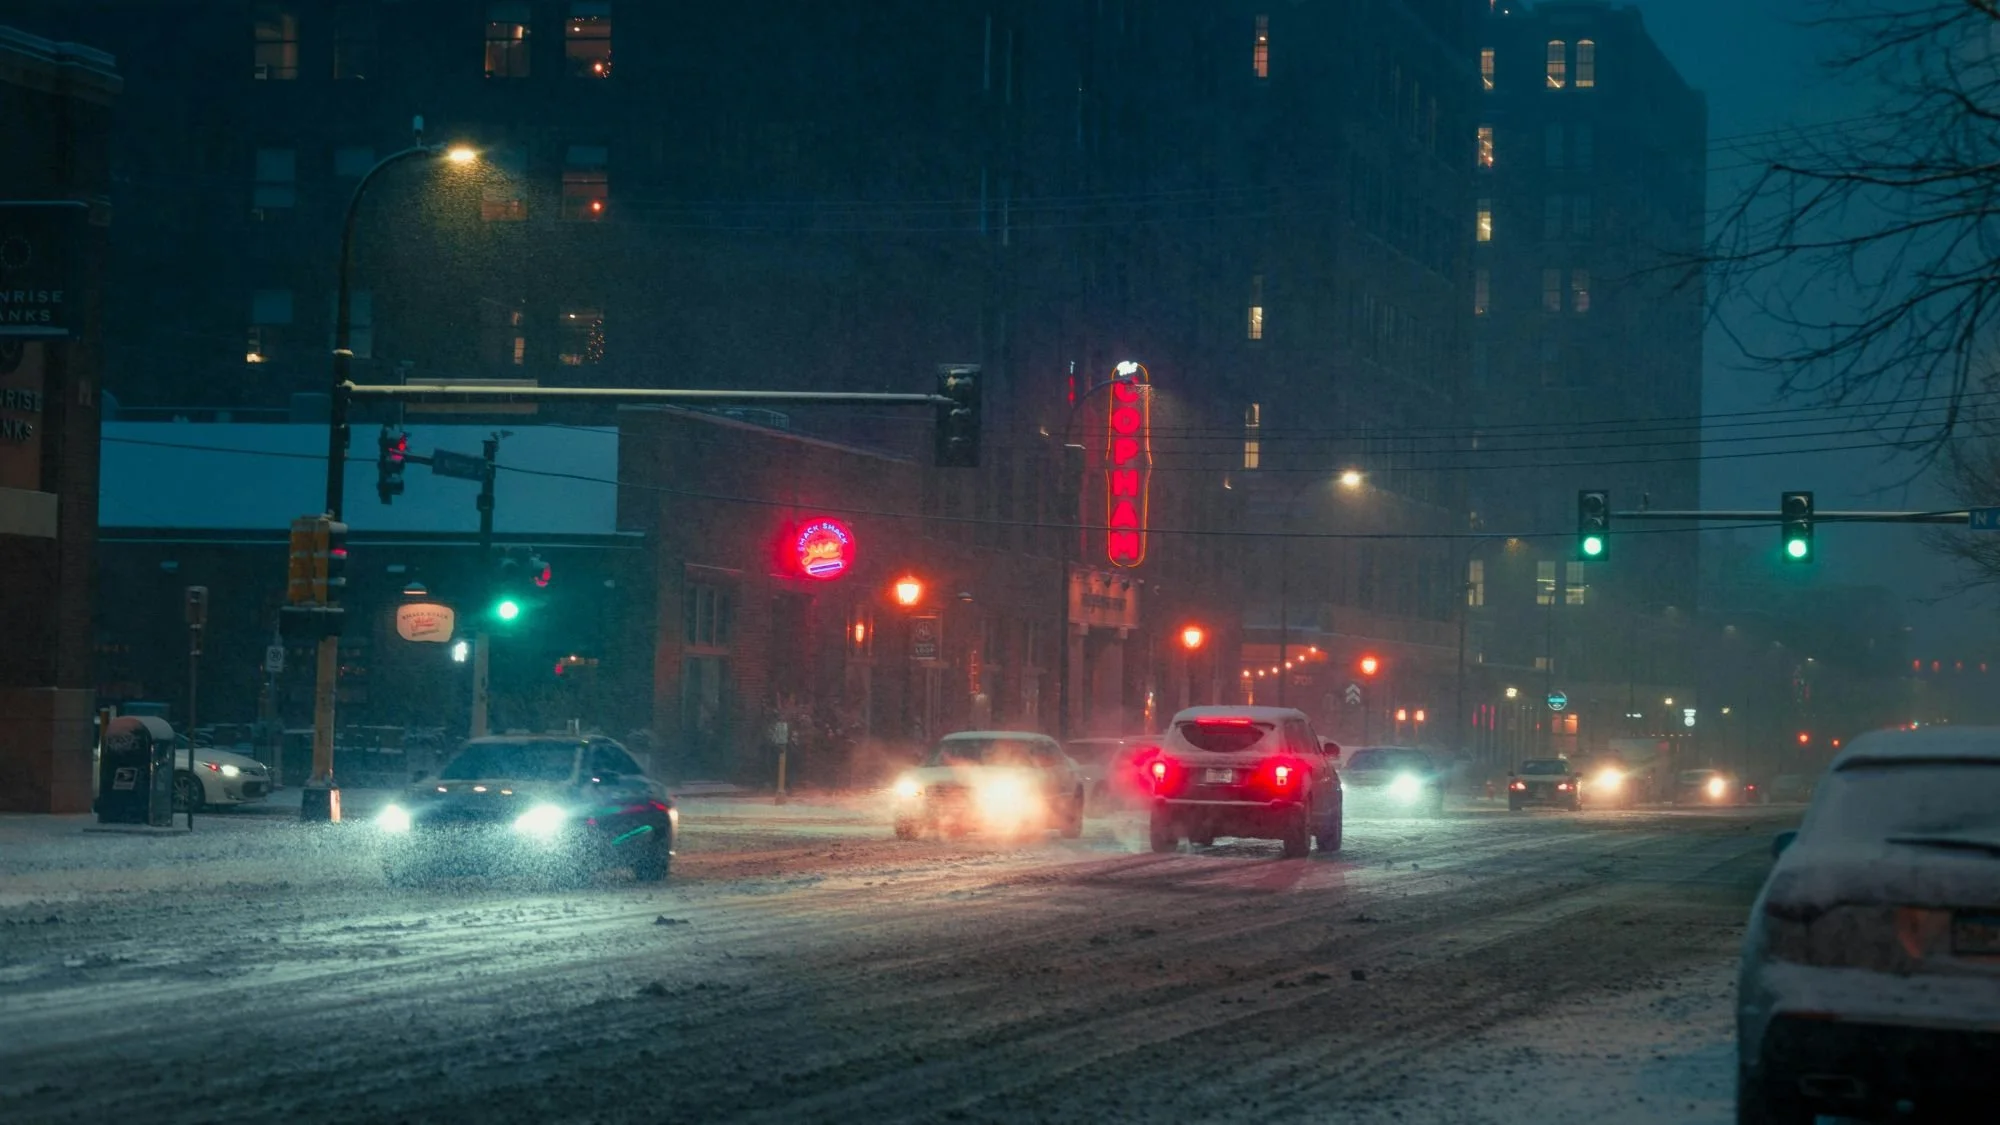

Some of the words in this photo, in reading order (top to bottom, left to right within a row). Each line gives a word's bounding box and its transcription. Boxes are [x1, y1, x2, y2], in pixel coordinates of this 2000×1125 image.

[1112, 376, 1141, 558] COPHAM
[1976, 512, 1987, 525] N
[797, 525, 819, 552] SMACK
[822, 522, 848, 544] SHACK
